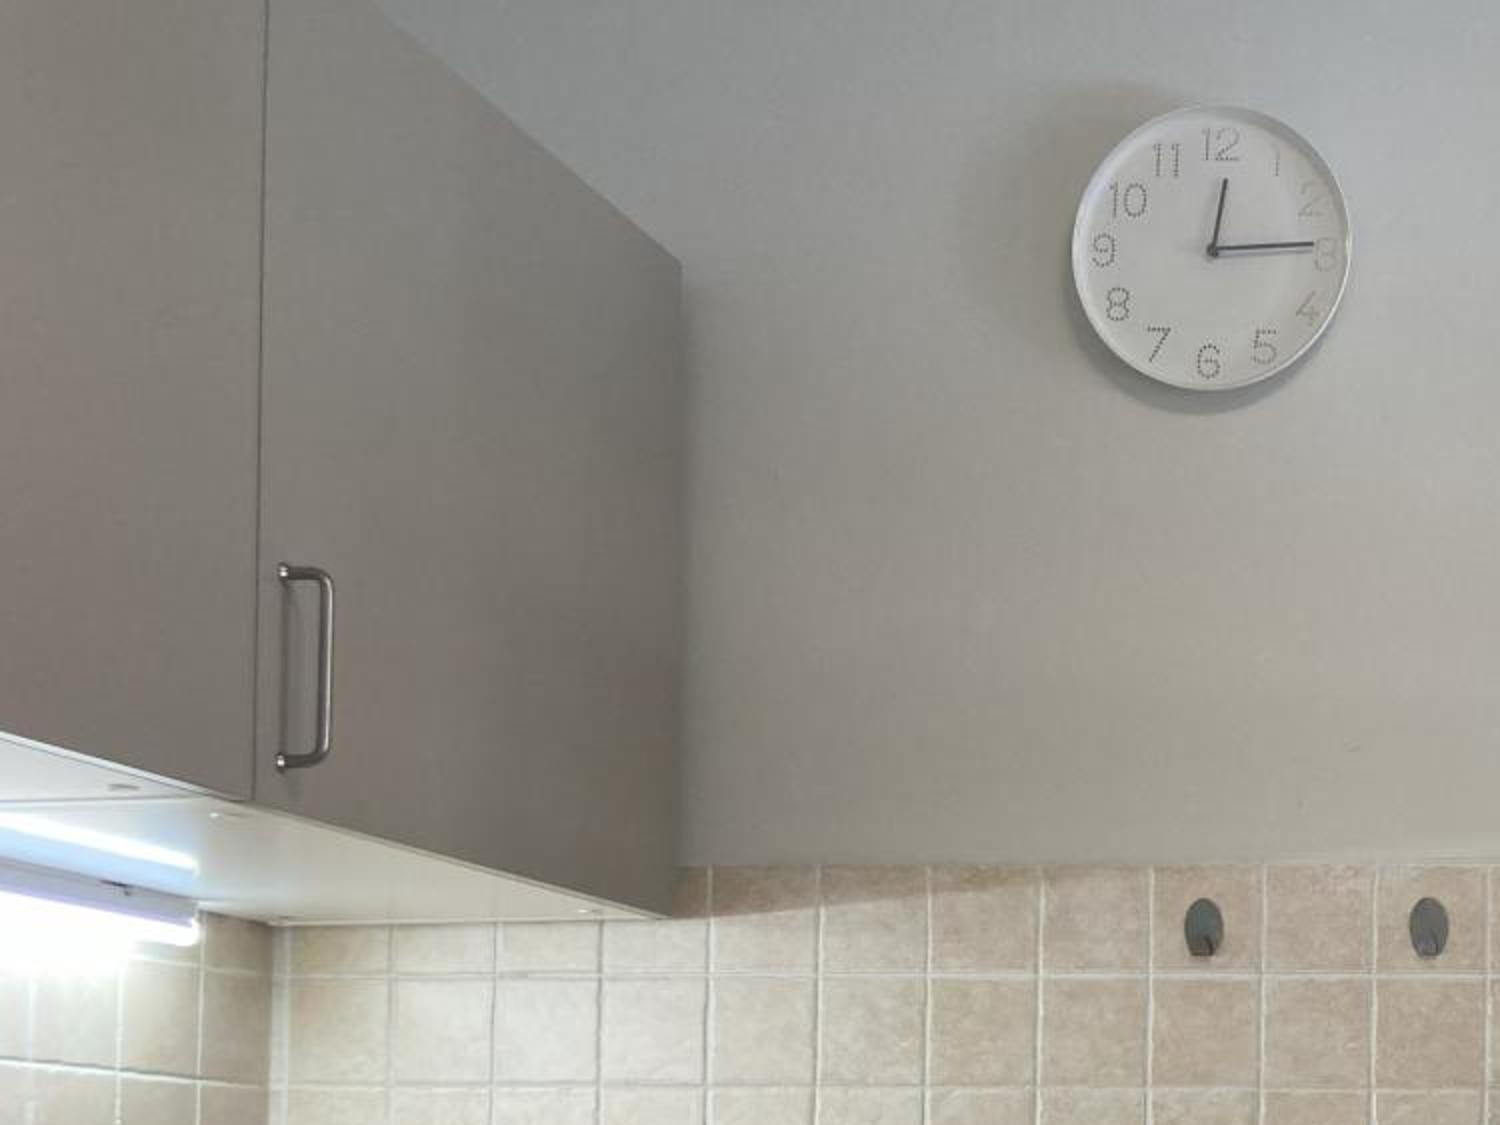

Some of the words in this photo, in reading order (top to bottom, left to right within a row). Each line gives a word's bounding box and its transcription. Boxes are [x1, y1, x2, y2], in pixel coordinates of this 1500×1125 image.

[1153, 142, 1181, 178] 11
[1201, 127, 1241, 162] 12
[1109, 181, 1148, 218] 10
[1298, 180, 1324, 217] 2
[1091, 232, 1116, 269] 9
[1313, 236, 1338, 273] 3
[1105, 286, 1131, 322] 8
[1295, 289, 1322, 327] 4
[1146, 325, 1172, 363] 7
[1196, 342, 1222, 380] 6
[1252, 328, 1278, 366] 5
